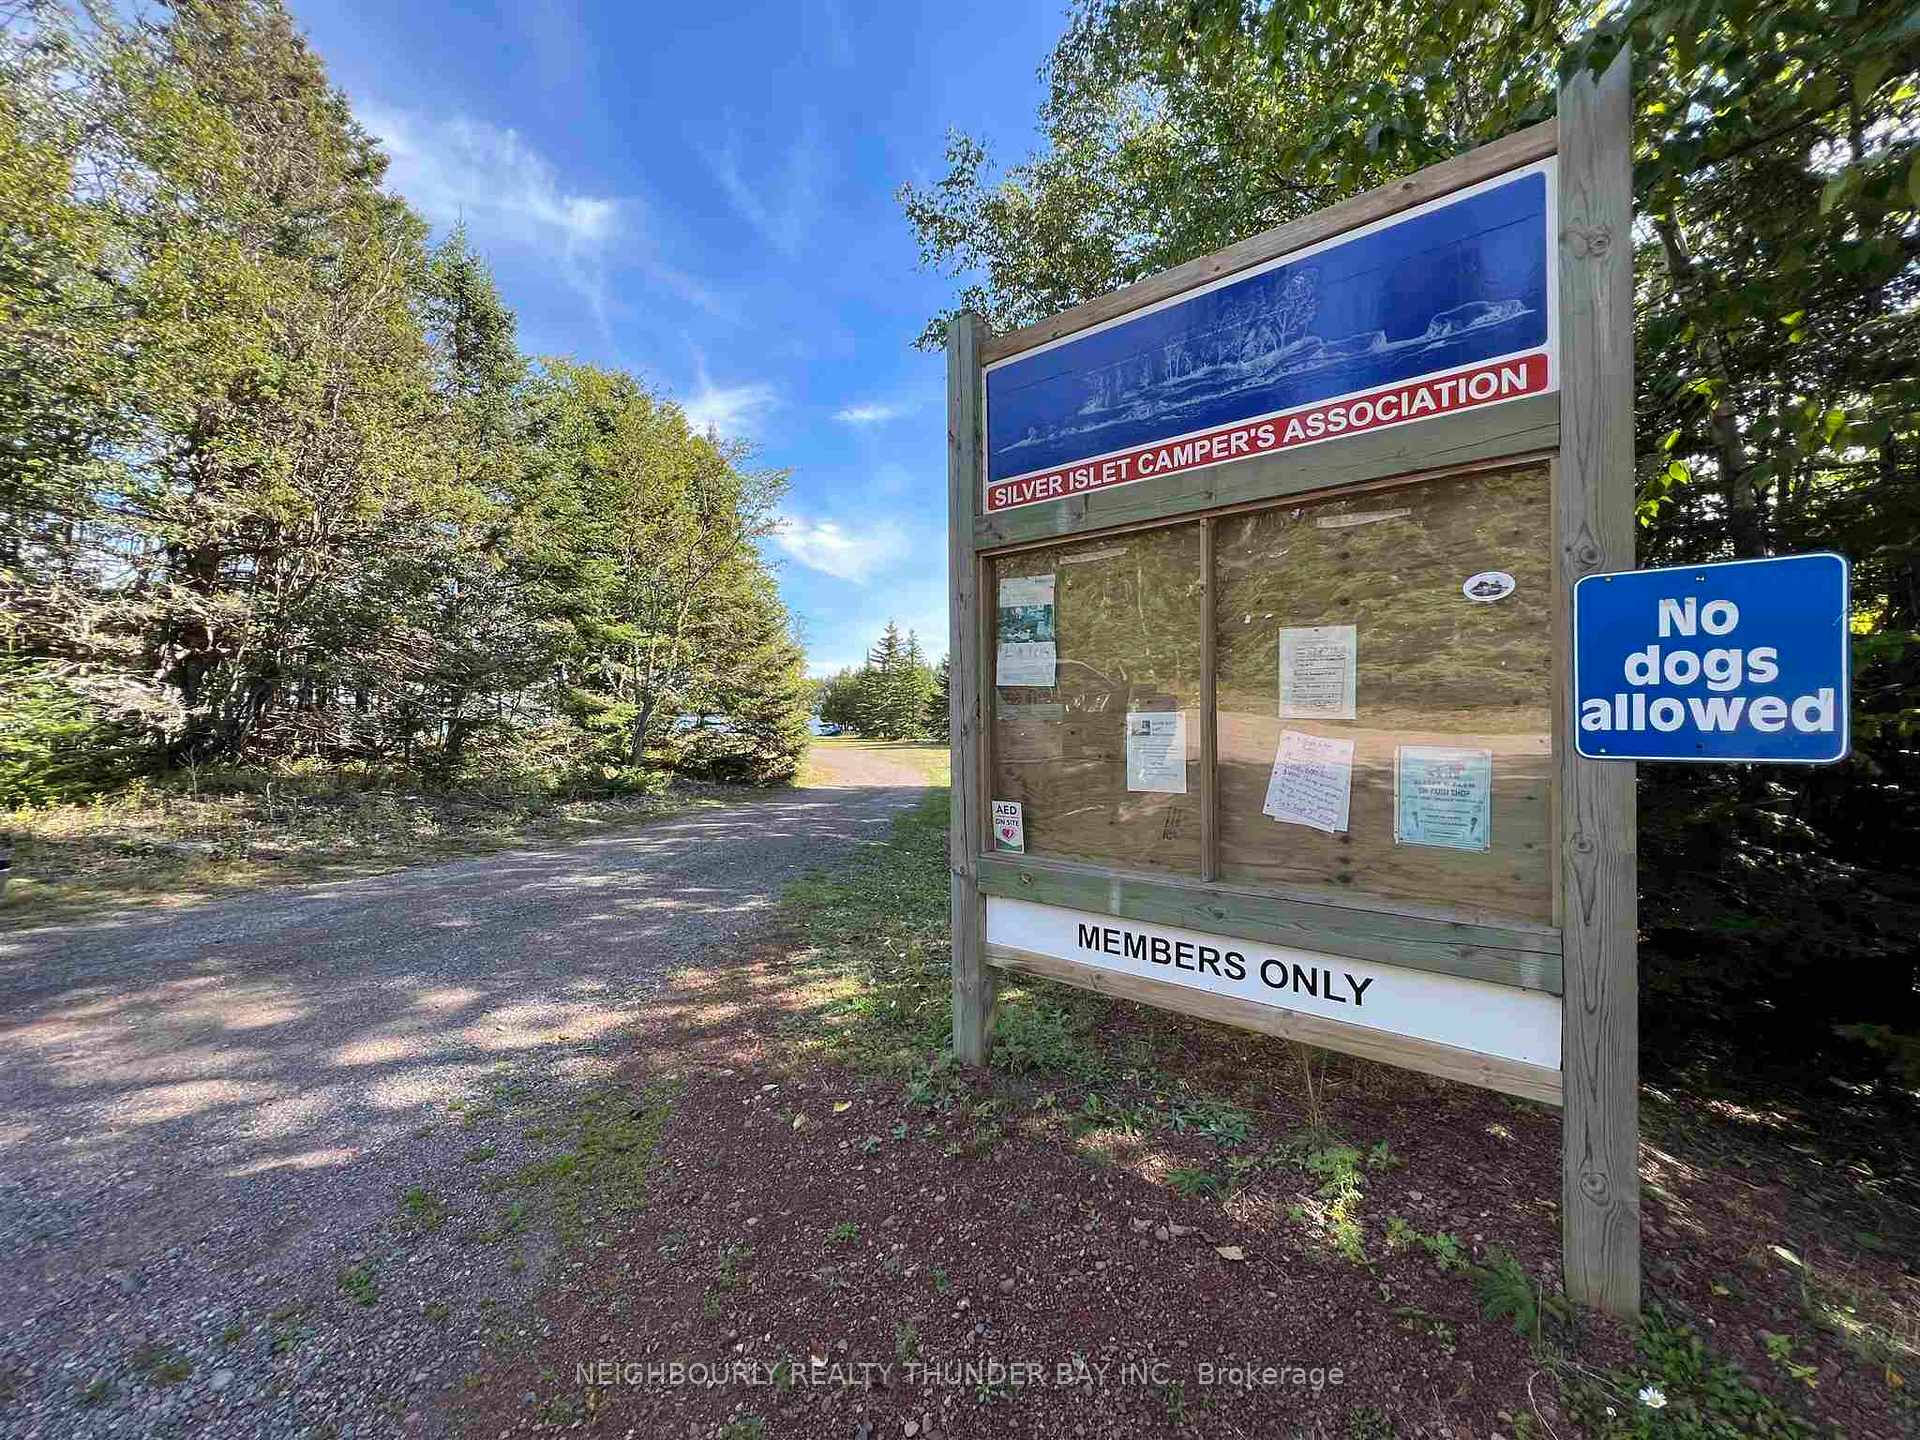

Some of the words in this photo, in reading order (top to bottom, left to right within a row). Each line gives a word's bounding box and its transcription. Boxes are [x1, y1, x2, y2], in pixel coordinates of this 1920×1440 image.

[994, 473, 1063, 508] SILVER
[1068, 457, 1131, 491] ISLET
[1137, 423, 1276, 475] CAMPER'S
[1283, 363, 1528, 443] ASSOCIATION
[1658, 596, 1740, 637] No
[1624, 644, 1779, 691] dogs
[1580, 688, 1835, 732] allowed
[995, 804, 1017, 815] AED
[1078, 923, 1247, 981] MEMBERS
[1259, 958, 1374, 1007] ONLY
